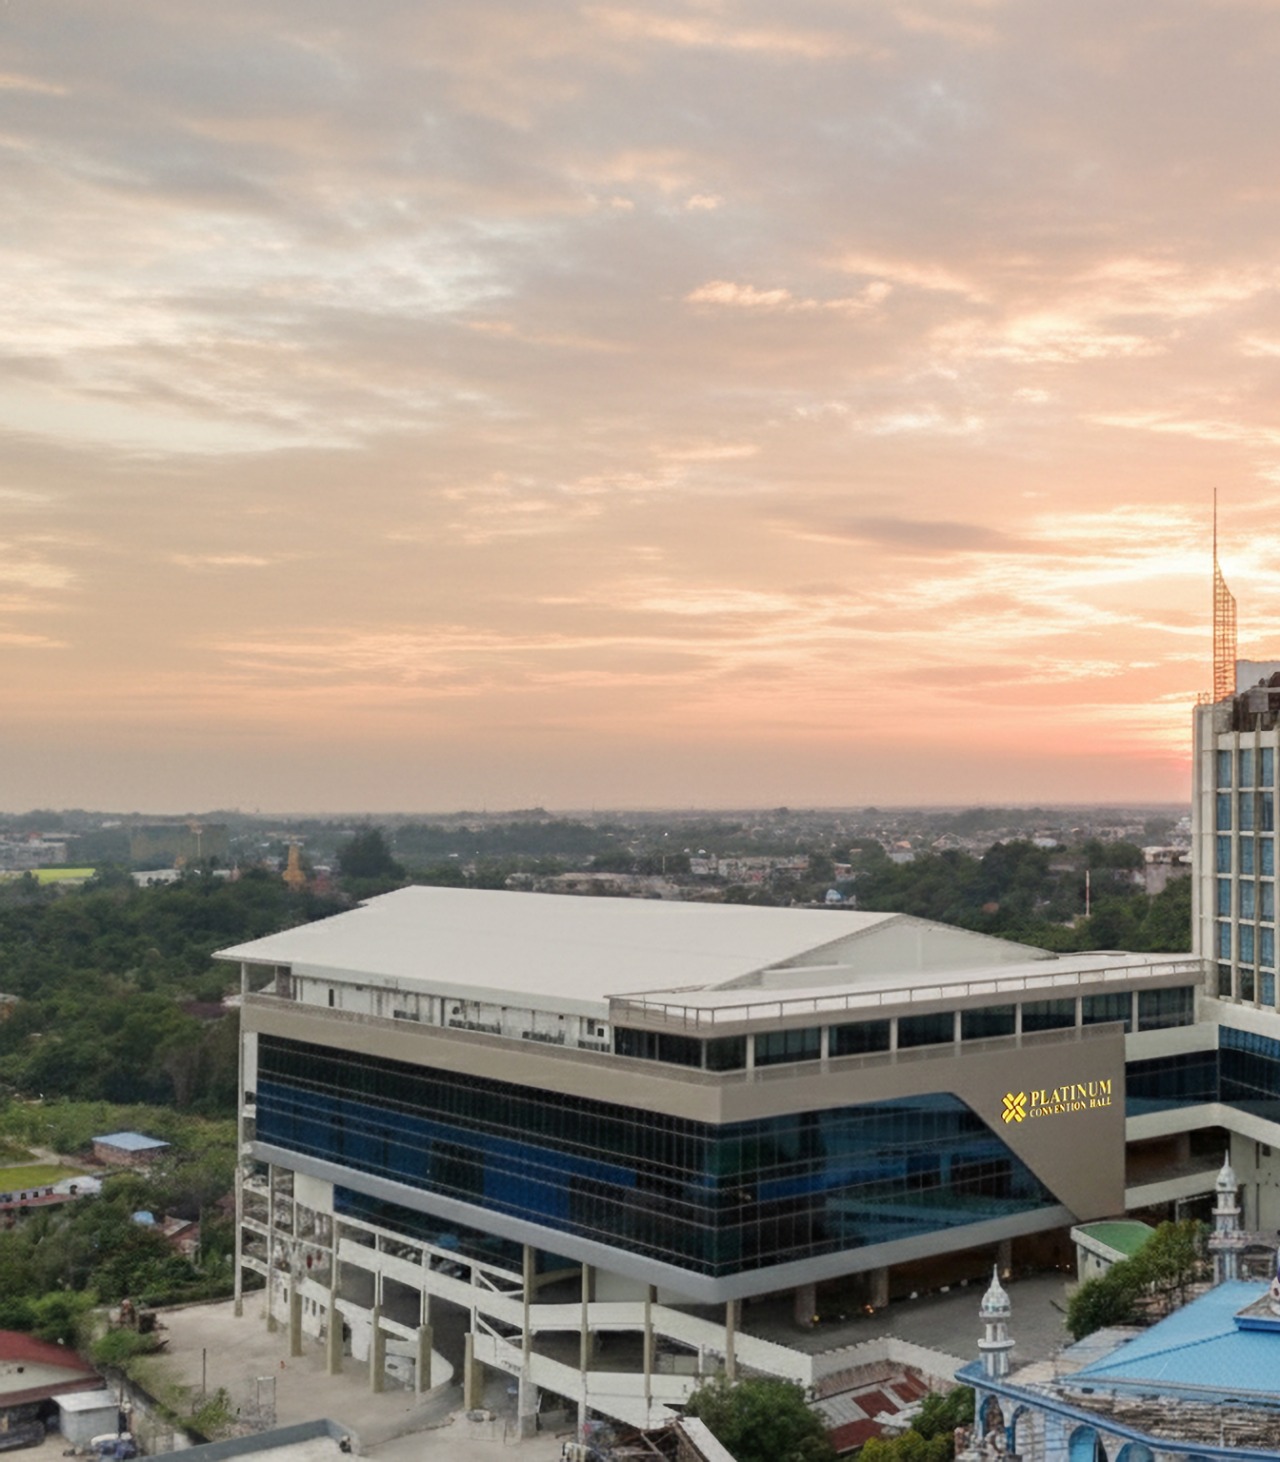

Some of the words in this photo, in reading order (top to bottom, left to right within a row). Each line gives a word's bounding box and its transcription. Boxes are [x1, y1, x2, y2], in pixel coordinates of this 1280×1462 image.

[1030, 1079, 1112, 1107] PLATINUM
[1029, 1101, 1086, 1118] CONVENTION
[1089, 1096, 1112, 1108] HALL
